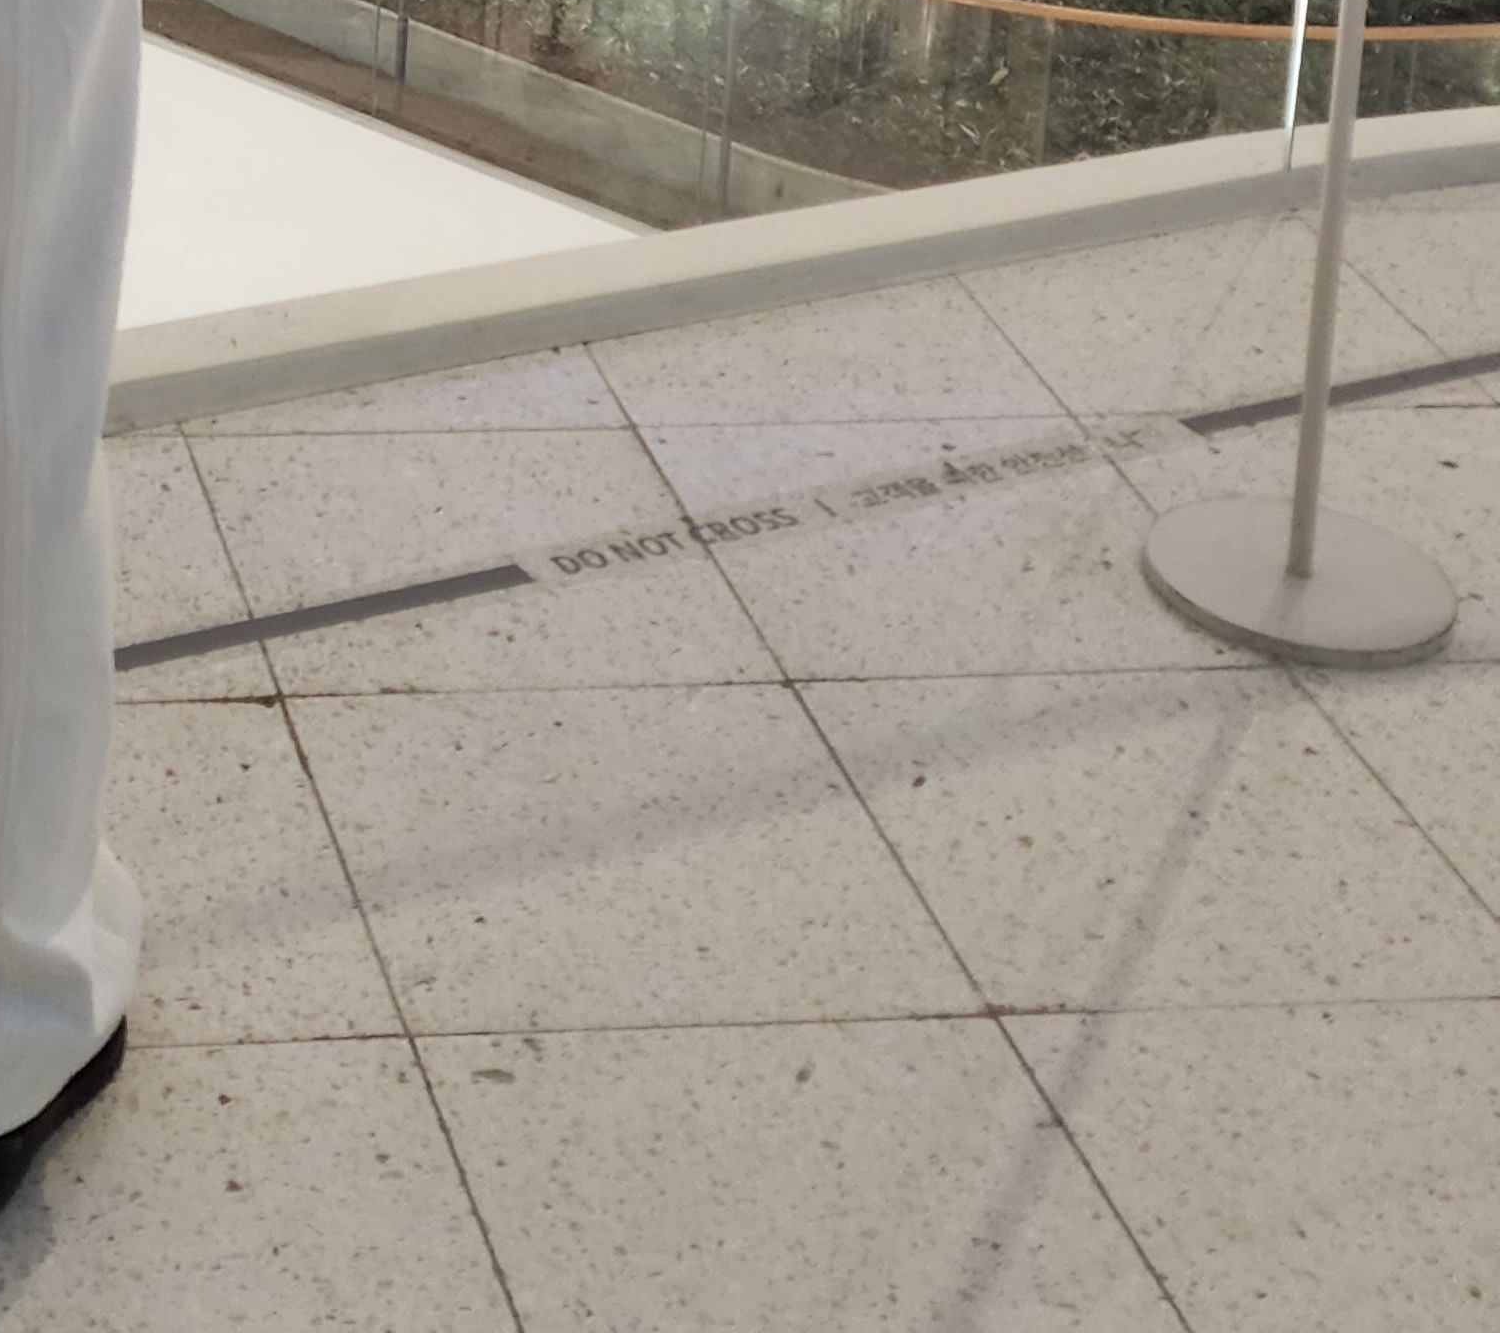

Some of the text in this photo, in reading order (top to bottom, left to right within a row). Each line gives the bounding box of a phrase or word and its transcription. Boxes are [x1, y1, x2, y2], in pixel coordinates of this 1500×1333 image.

[550, 507, 799, 575] DO NOT CROSS
